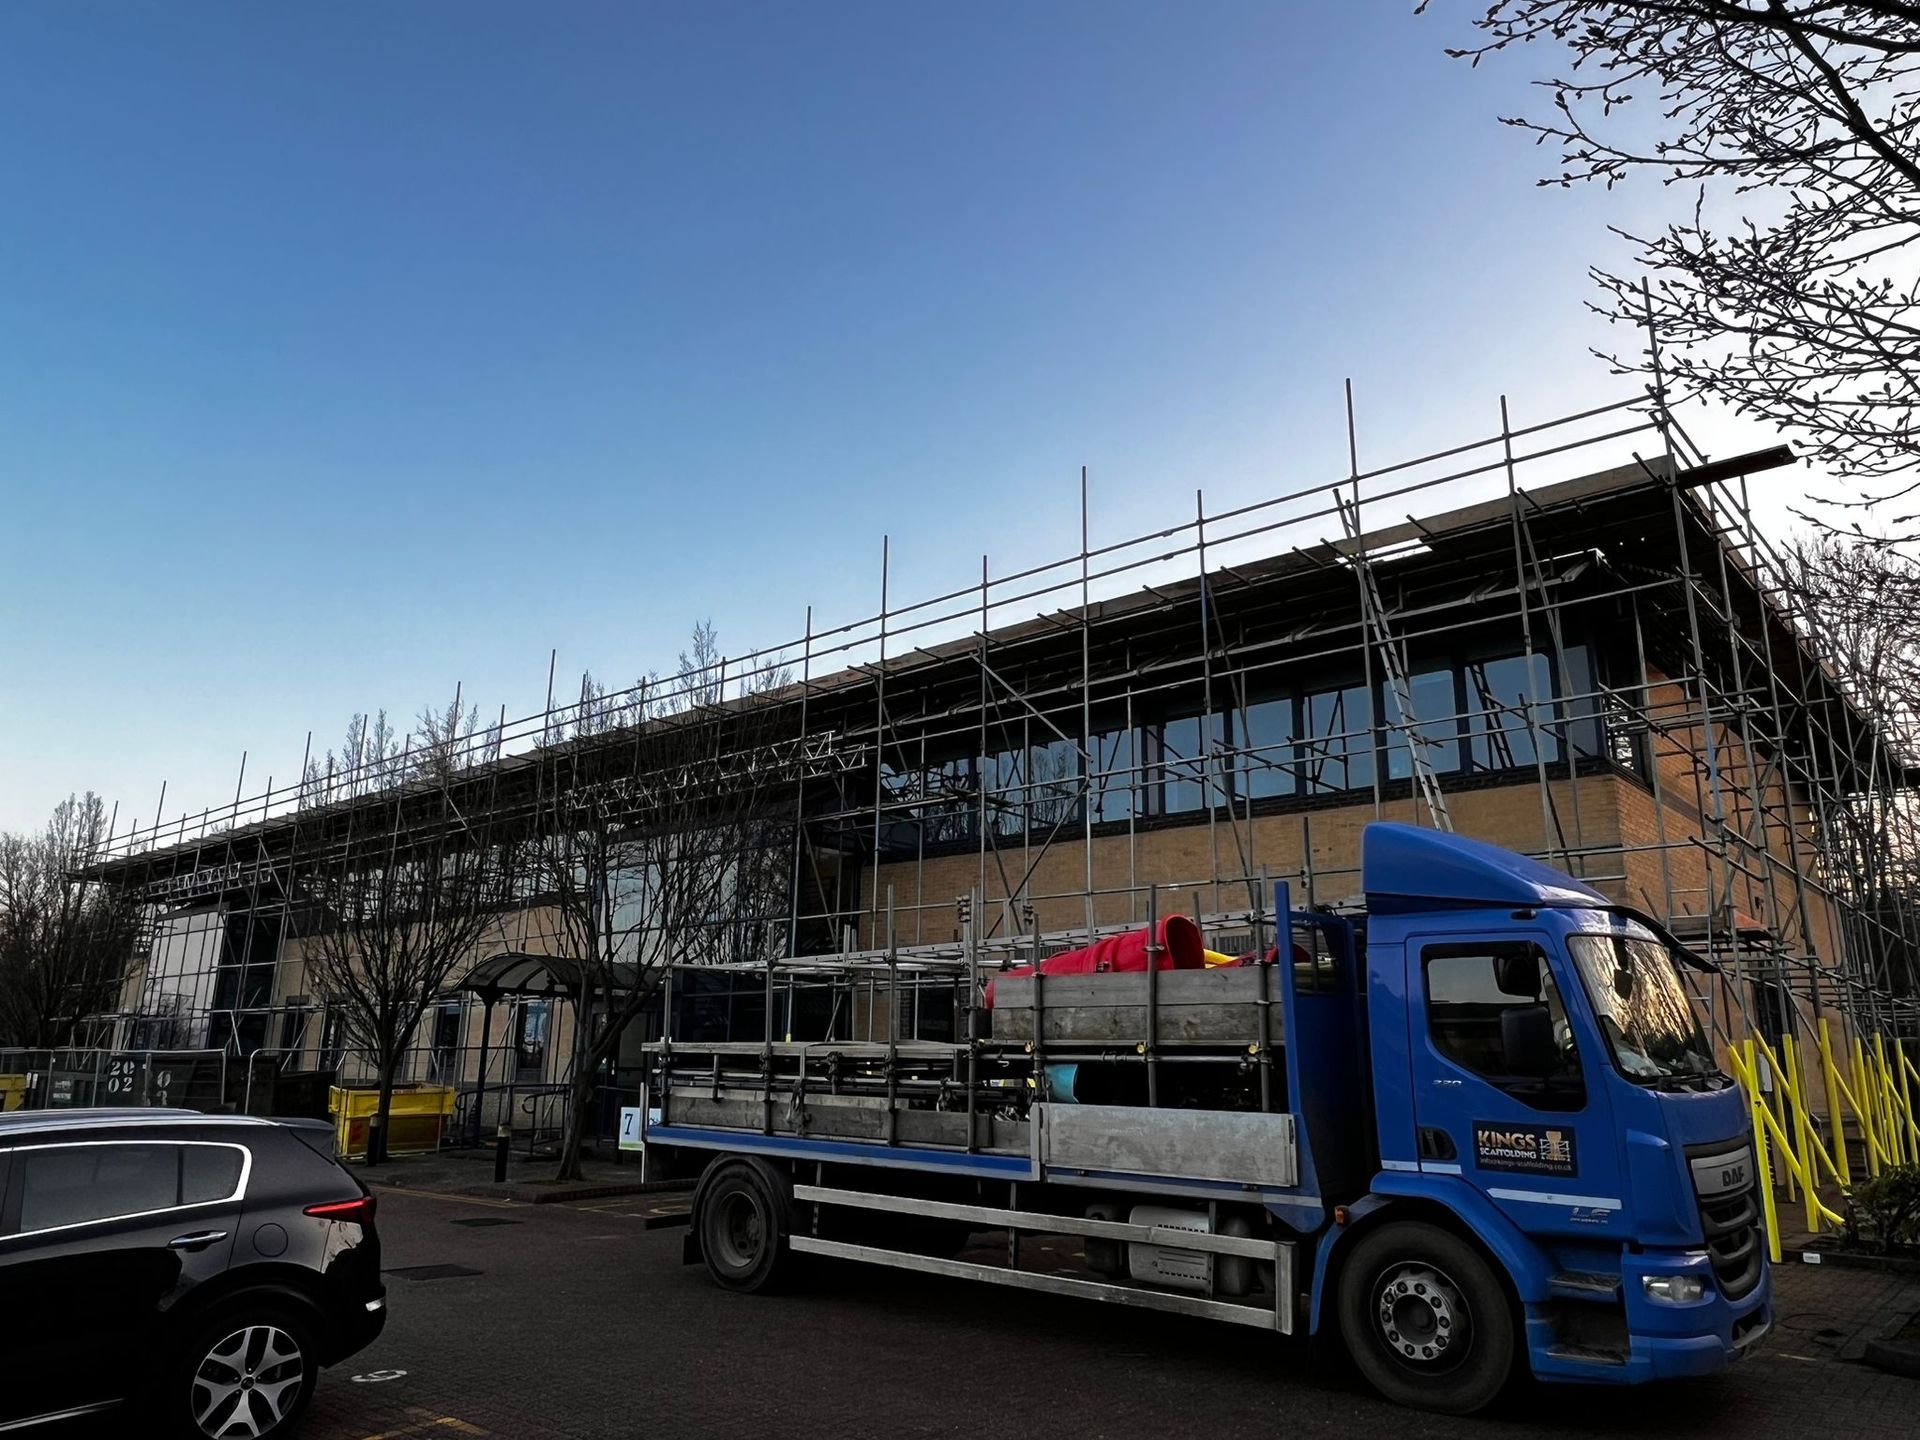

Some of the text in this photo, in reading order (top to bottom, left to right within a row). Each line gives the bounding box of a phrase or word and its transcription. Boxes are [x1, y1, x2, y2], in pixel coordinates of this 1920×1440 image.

[108, 1077, 133, 1093] 02
[624, 1113, 633, 1135] 7
[1478, 1130, 1537, 1150] KINGS
[1480, 1147, 1537, 1160] SCAFFOLDING
[1722, 1166, 1744, 1187] DAF
